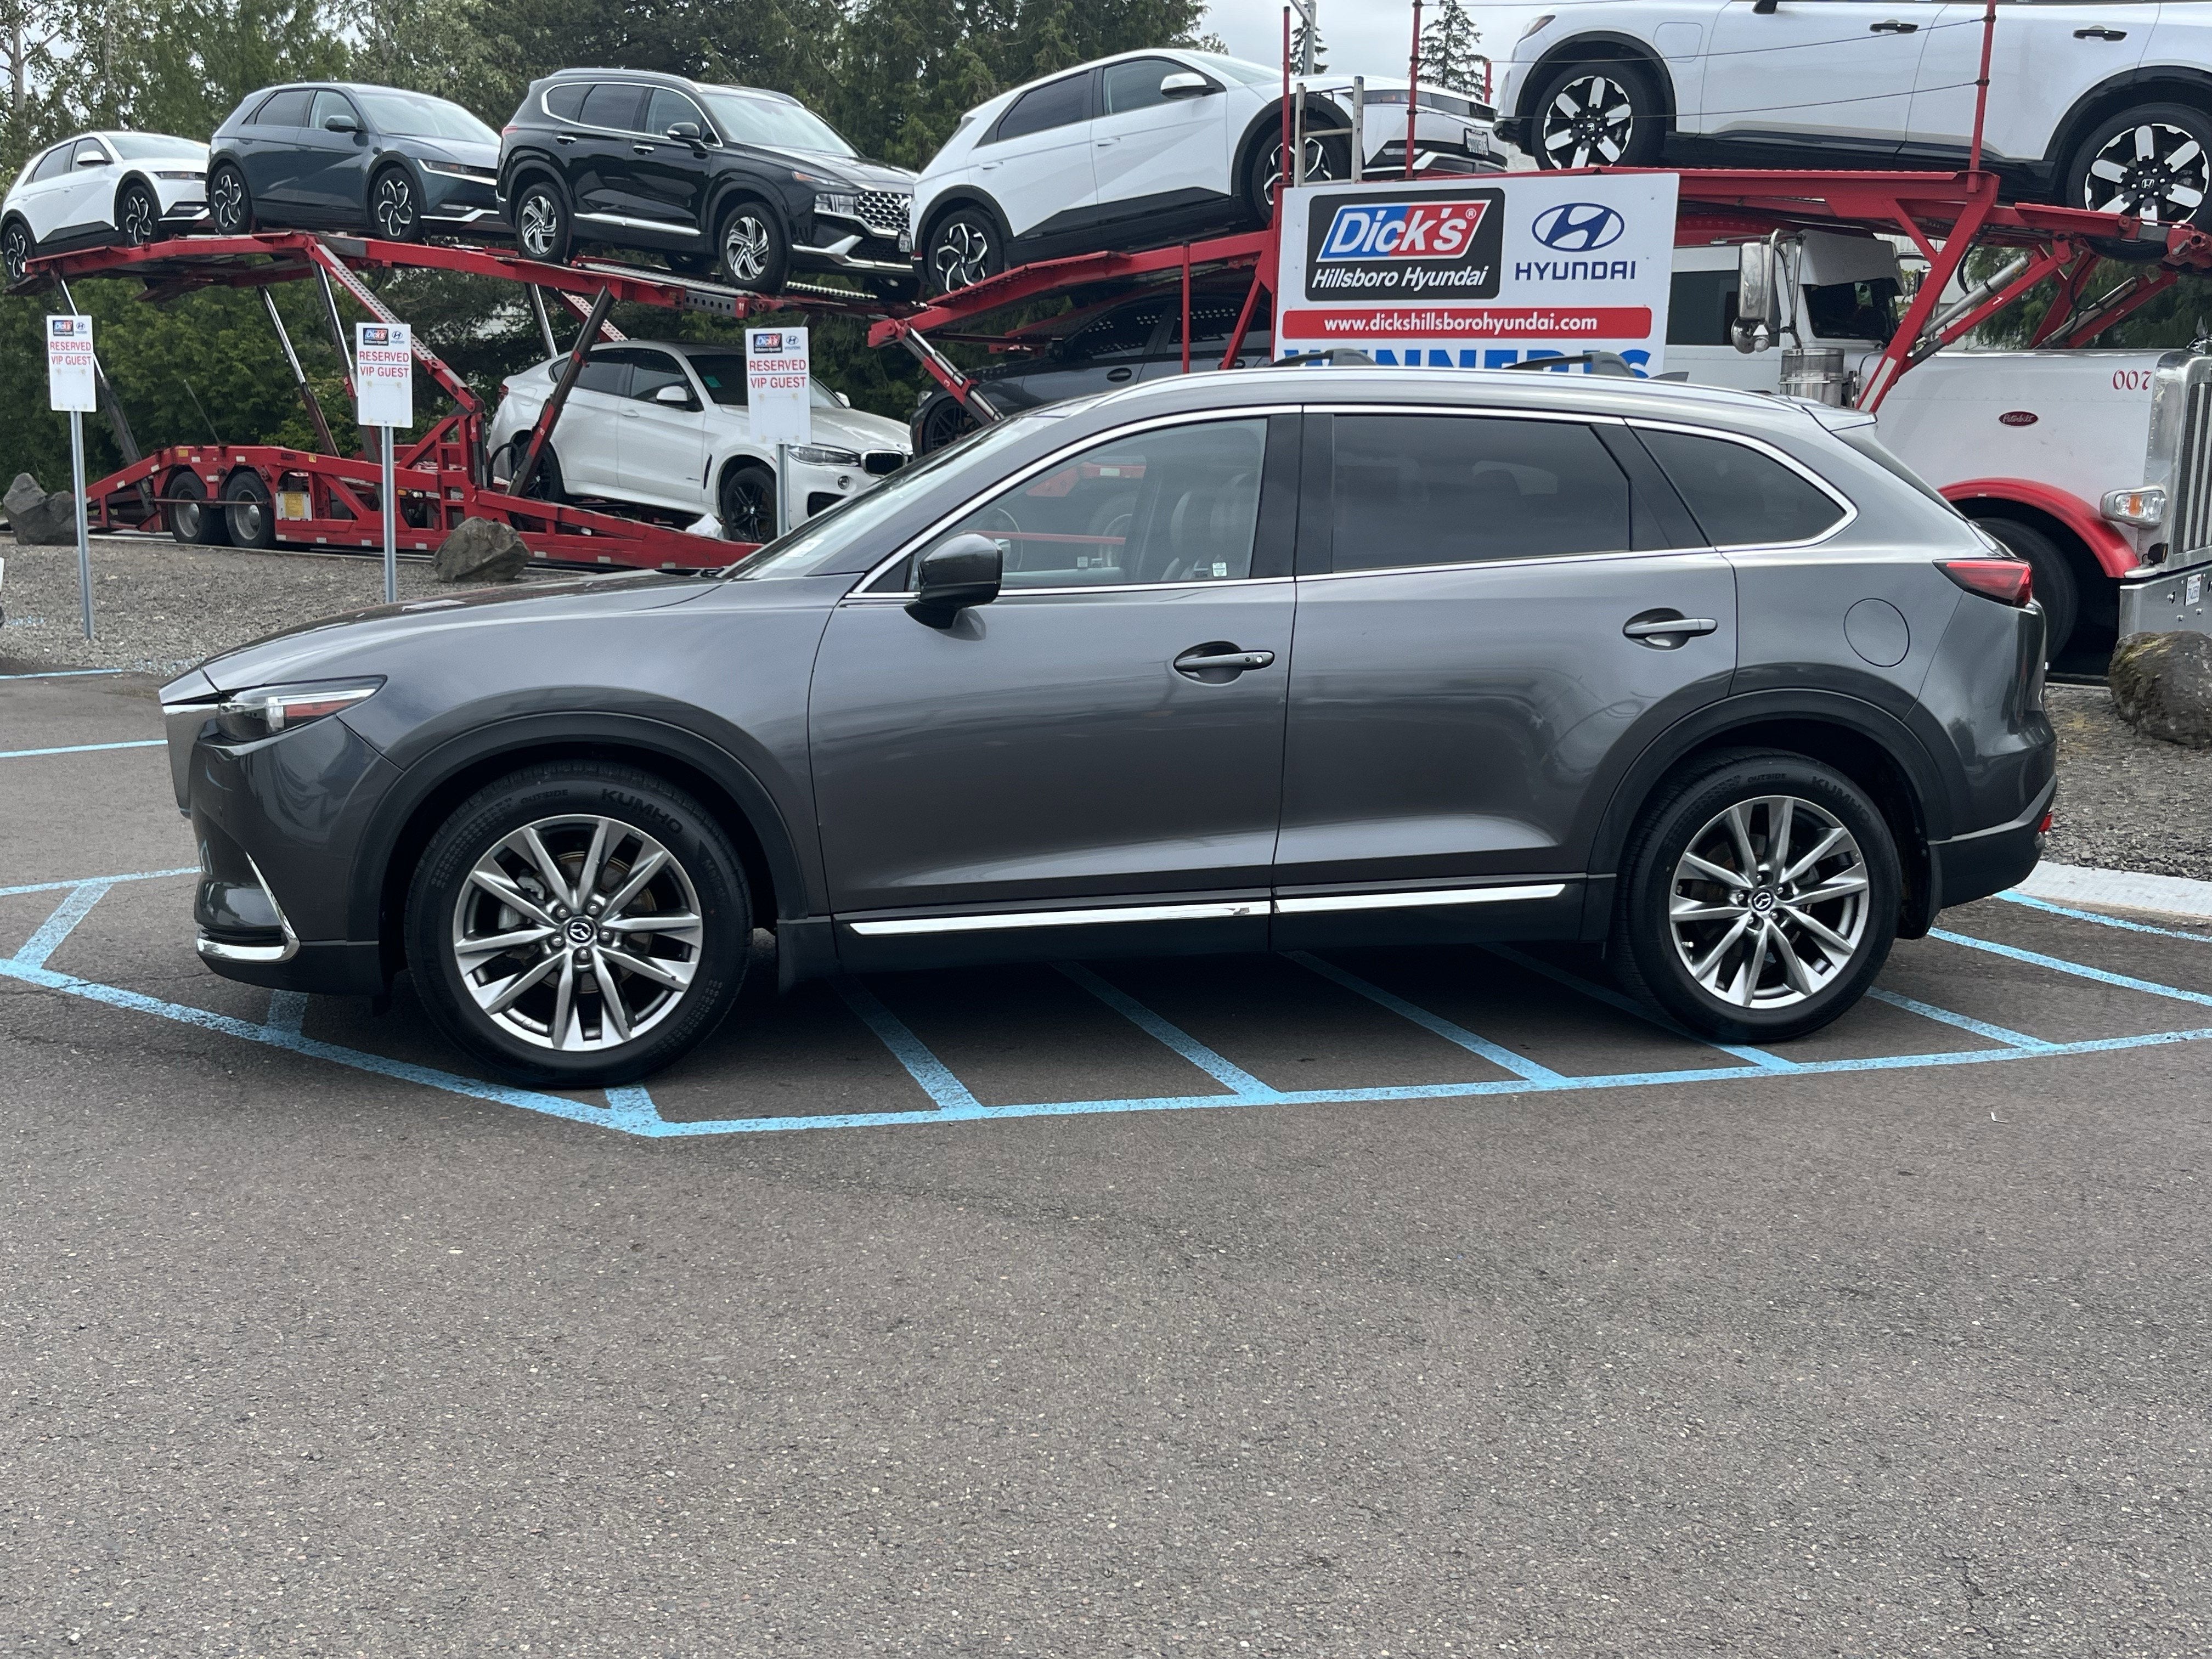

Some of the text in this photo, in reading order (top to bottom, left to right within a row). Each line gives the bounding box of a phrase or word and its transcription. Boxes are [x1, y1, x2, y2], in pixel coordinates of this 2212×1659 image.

[1329, 207, 1468, 253] Dick's
[1311, 266, 1489, 292] Hillsboro Hyundai
[1515, 261, 1636, 281] HYUNDAI
[1324, 311, 1597, 335] www.dickshillsborohyundai.com
[50, 341, 92, 351] RESERVED
[51, 356, 92, 365] VIP GUEST
[359, 351, 409, 363] RESERVED
[749, 359, 806, 371] RESERVED
[360, 366, 409, 378] VIP GUEST
[2113, 369, 2153, 390] 007
[751, 376, 806, 389] VIP GUEST
[602, 788, 684, 834] KUMHO
